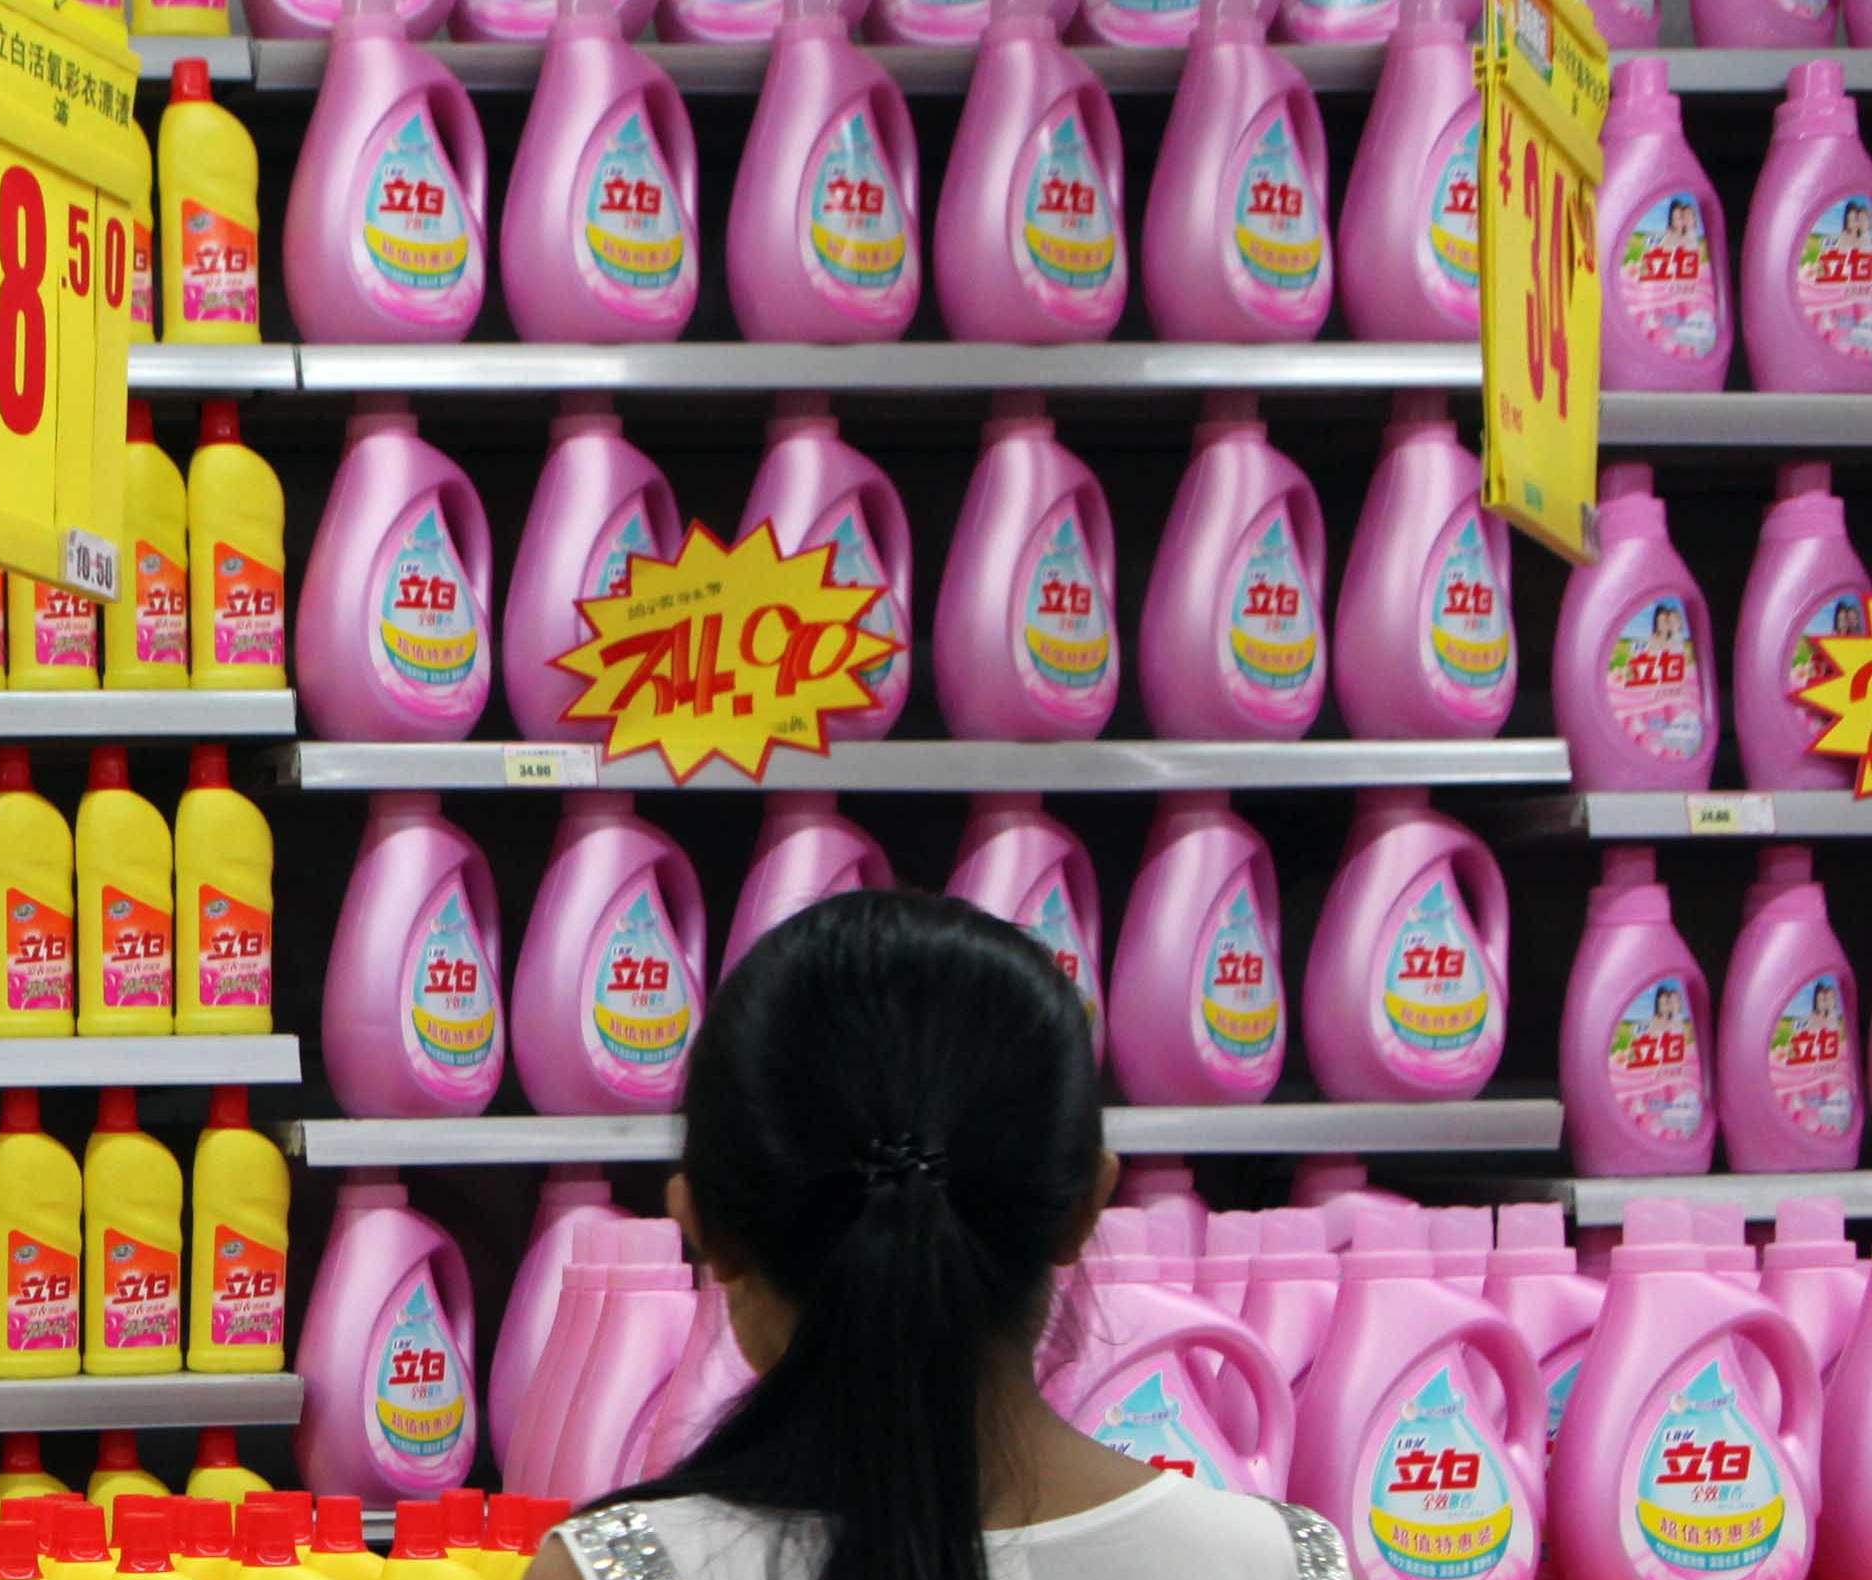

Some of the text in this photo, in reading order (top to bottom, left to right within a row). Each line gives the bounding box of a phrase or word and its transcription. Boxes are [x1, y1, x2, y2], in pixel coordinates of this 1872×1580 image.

[380, 179, 444, 215] 立白
[1639, 246, 1699, 281] 立白
[389, 1349, 445, 1385] 立白
[1390, 1449, 1479, 1492] 立白
[1657, 1441, 1751, 1484] 立白
